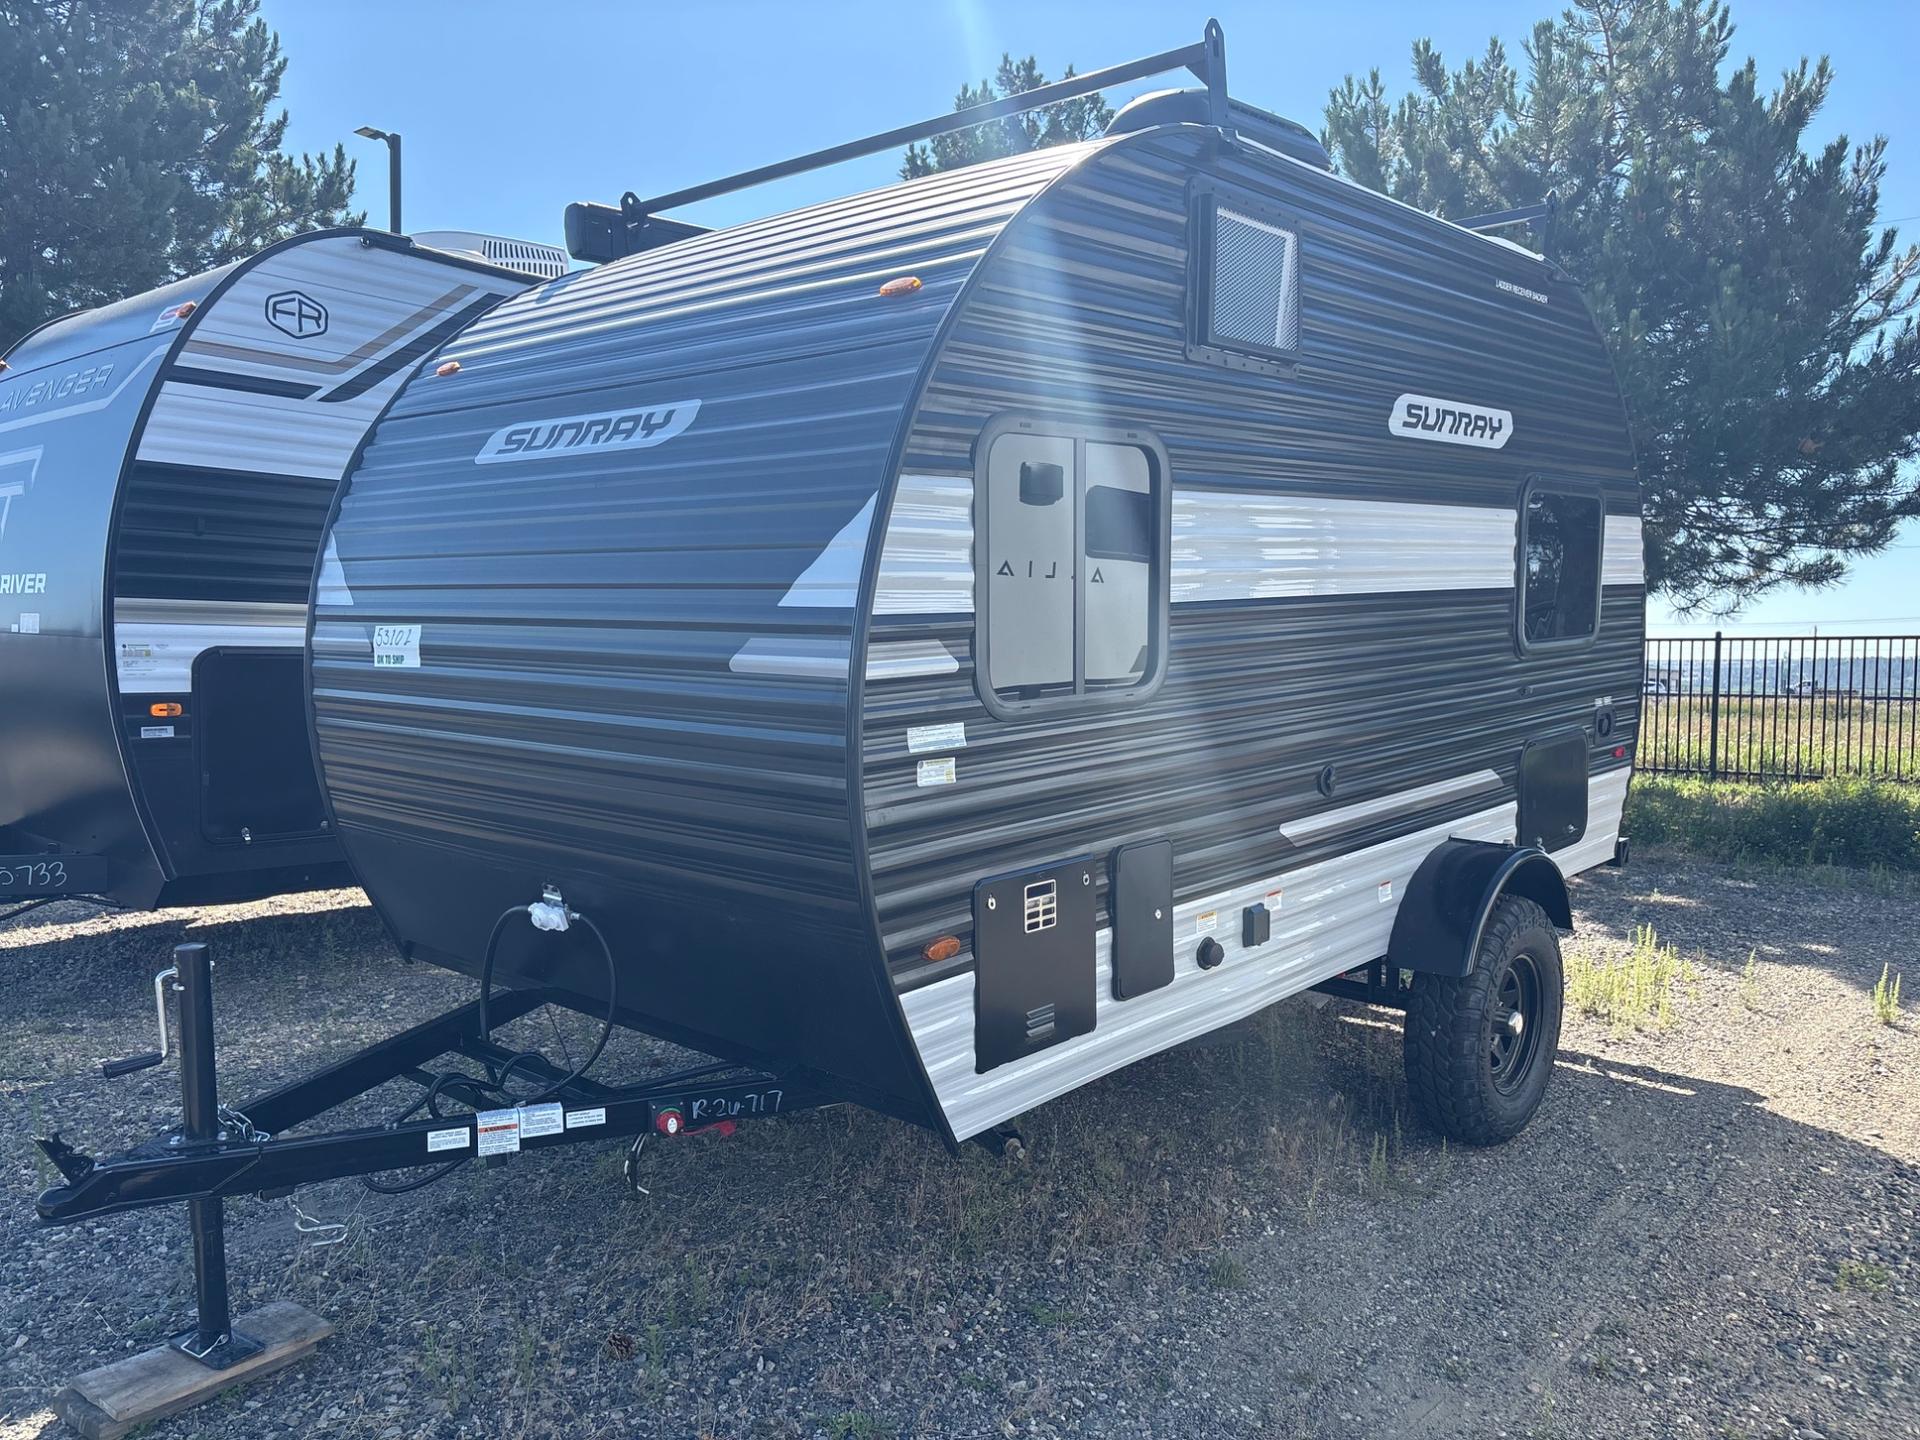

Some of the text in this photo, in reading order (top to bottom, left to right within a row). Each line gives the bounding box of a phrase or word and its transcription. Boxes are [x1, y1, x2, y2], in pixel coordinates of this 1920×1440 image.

[0, 363, 114, 412] AVENGER
[495, 408, 678, 455] SUNRAY
[1401, 403, 1503, 440] SUNRAY
[0, 573, 47, 594] RIVER
